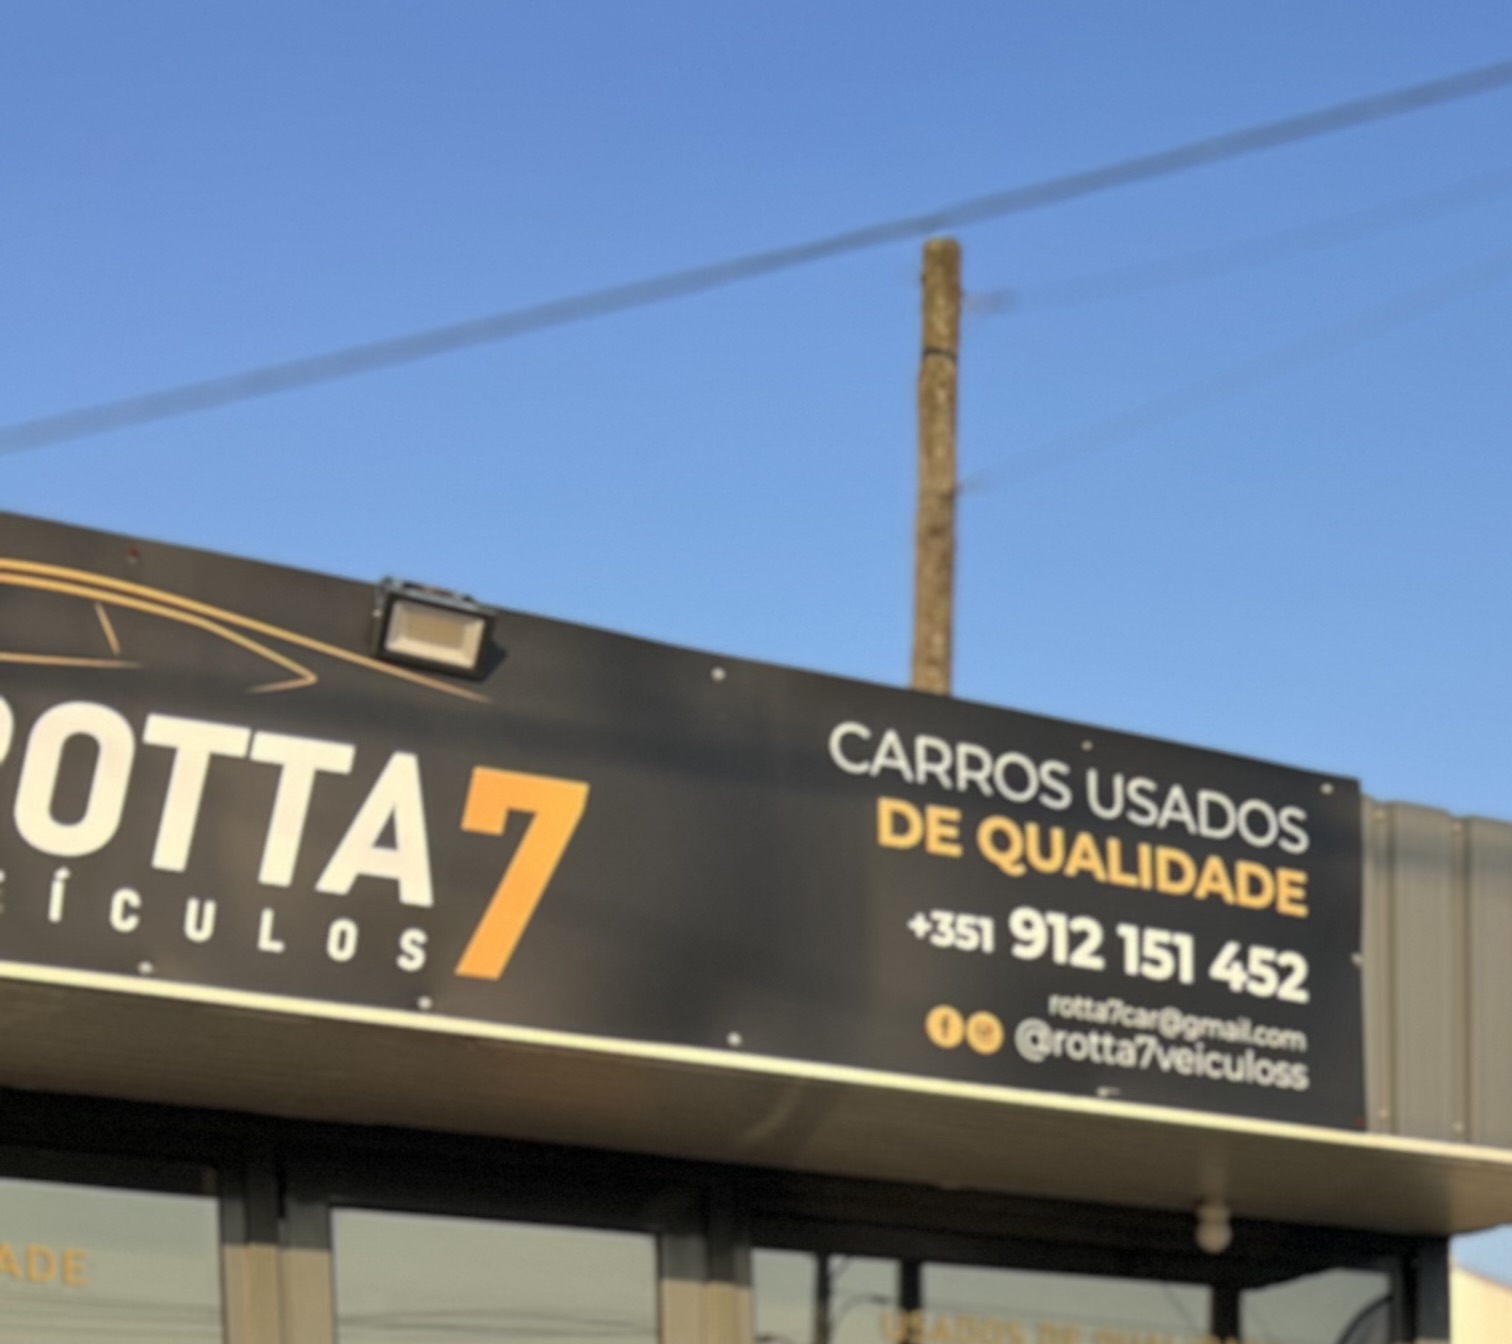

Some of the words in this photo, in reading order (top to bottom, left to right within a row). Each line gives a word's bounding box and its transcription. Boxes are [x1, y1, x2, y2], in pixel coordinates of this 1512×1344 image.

[0, 694, 590, 980] OTTA7
[829, 721, 1073, 810] CARROS
[1085, 768, 1310, 854] USADOS
[877, 796, 963, 857] DE
[976, 816, 1309, 917] QUALIDADE
[0, 865, 428, 972] ÍCULOS
[907, 910, 994, 953] +351
[1008, 906, 1105, 970] 912
[1116, 922, 1194, 984] 151
[1208, 941, 1309, 1003] 452
[1014, 1017, 1309, 1091] @rotta7veiculoss
[1048, 995, 1306, 1051] rotta7car@gmail.com
